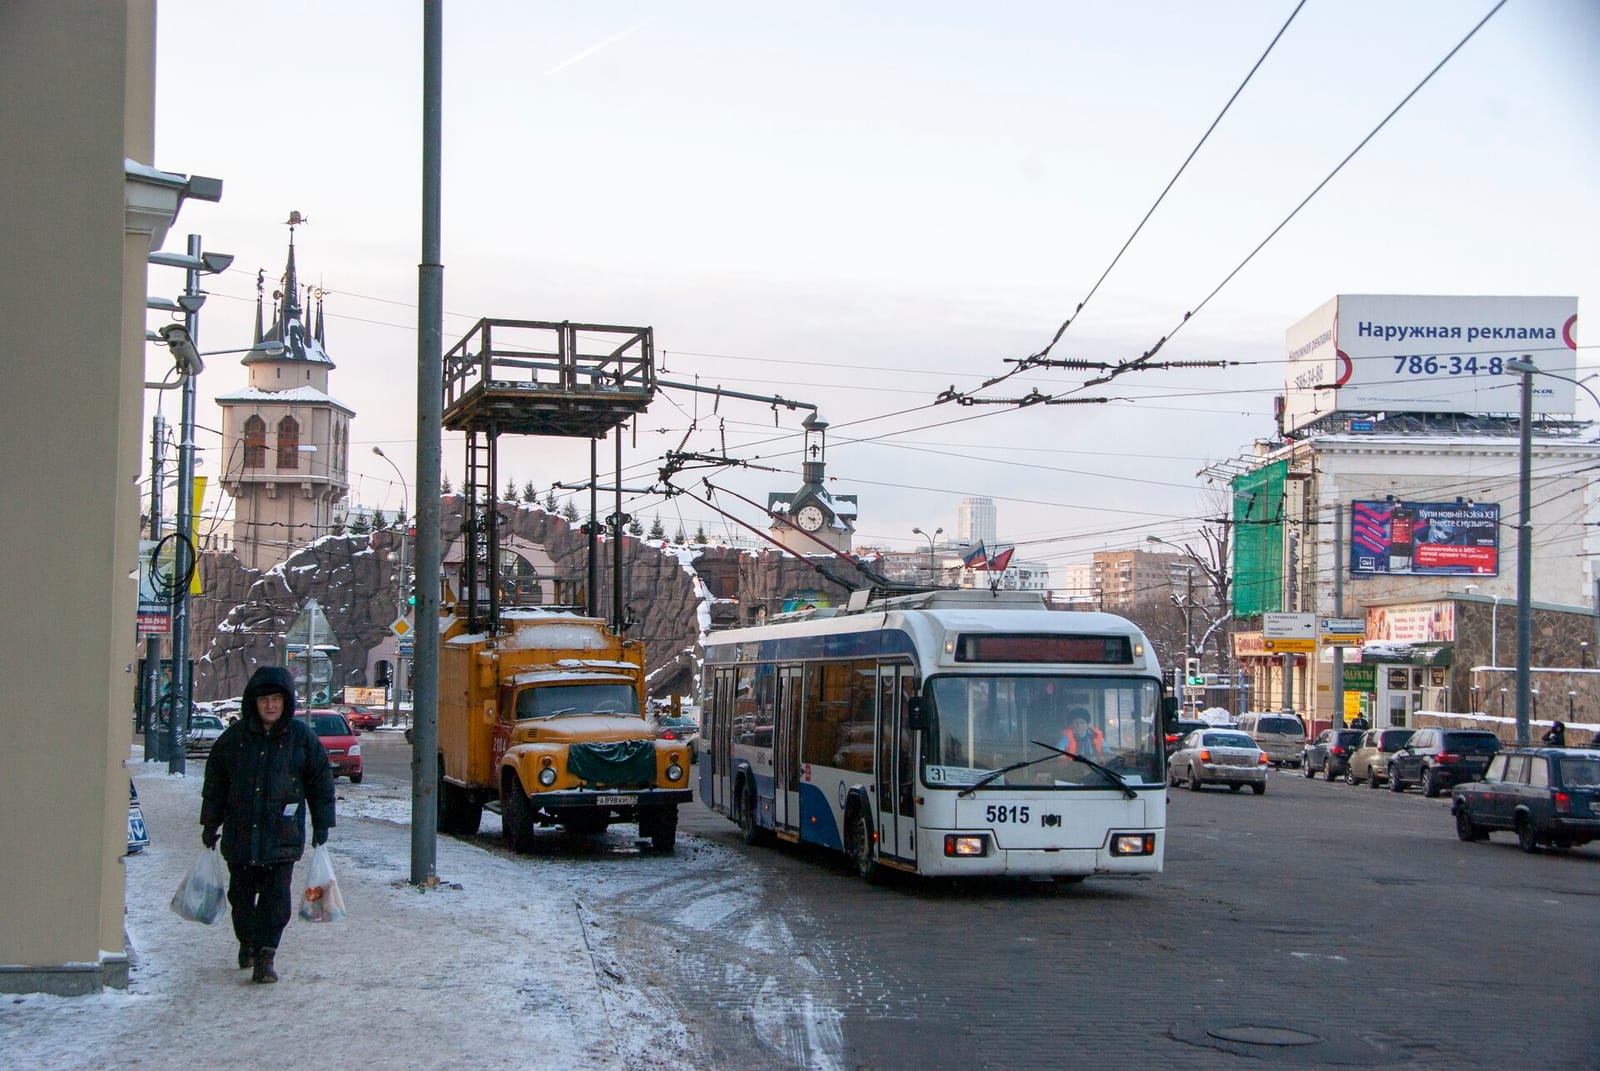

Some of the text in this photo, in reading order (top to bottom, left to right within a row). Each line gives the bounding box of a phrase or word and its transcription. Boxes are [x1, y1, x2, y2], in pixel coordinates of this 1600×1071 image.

[1358, 321, 1556, 342] Наружная реклама
[1393, 355, 1518, 375] 786-34-8
[1419, 509, 1438, 519] Купи
[1438, 509, 1463, 519] новый
[1463, 510, 1484, 519] Nokia
[1430, 518, 1456, 528] Вместе
[1343, 669, 1373, 680] ОДУКТЫ
[931, 768, 946, 781] 31
[986, 805, 1030, 824] 5815
